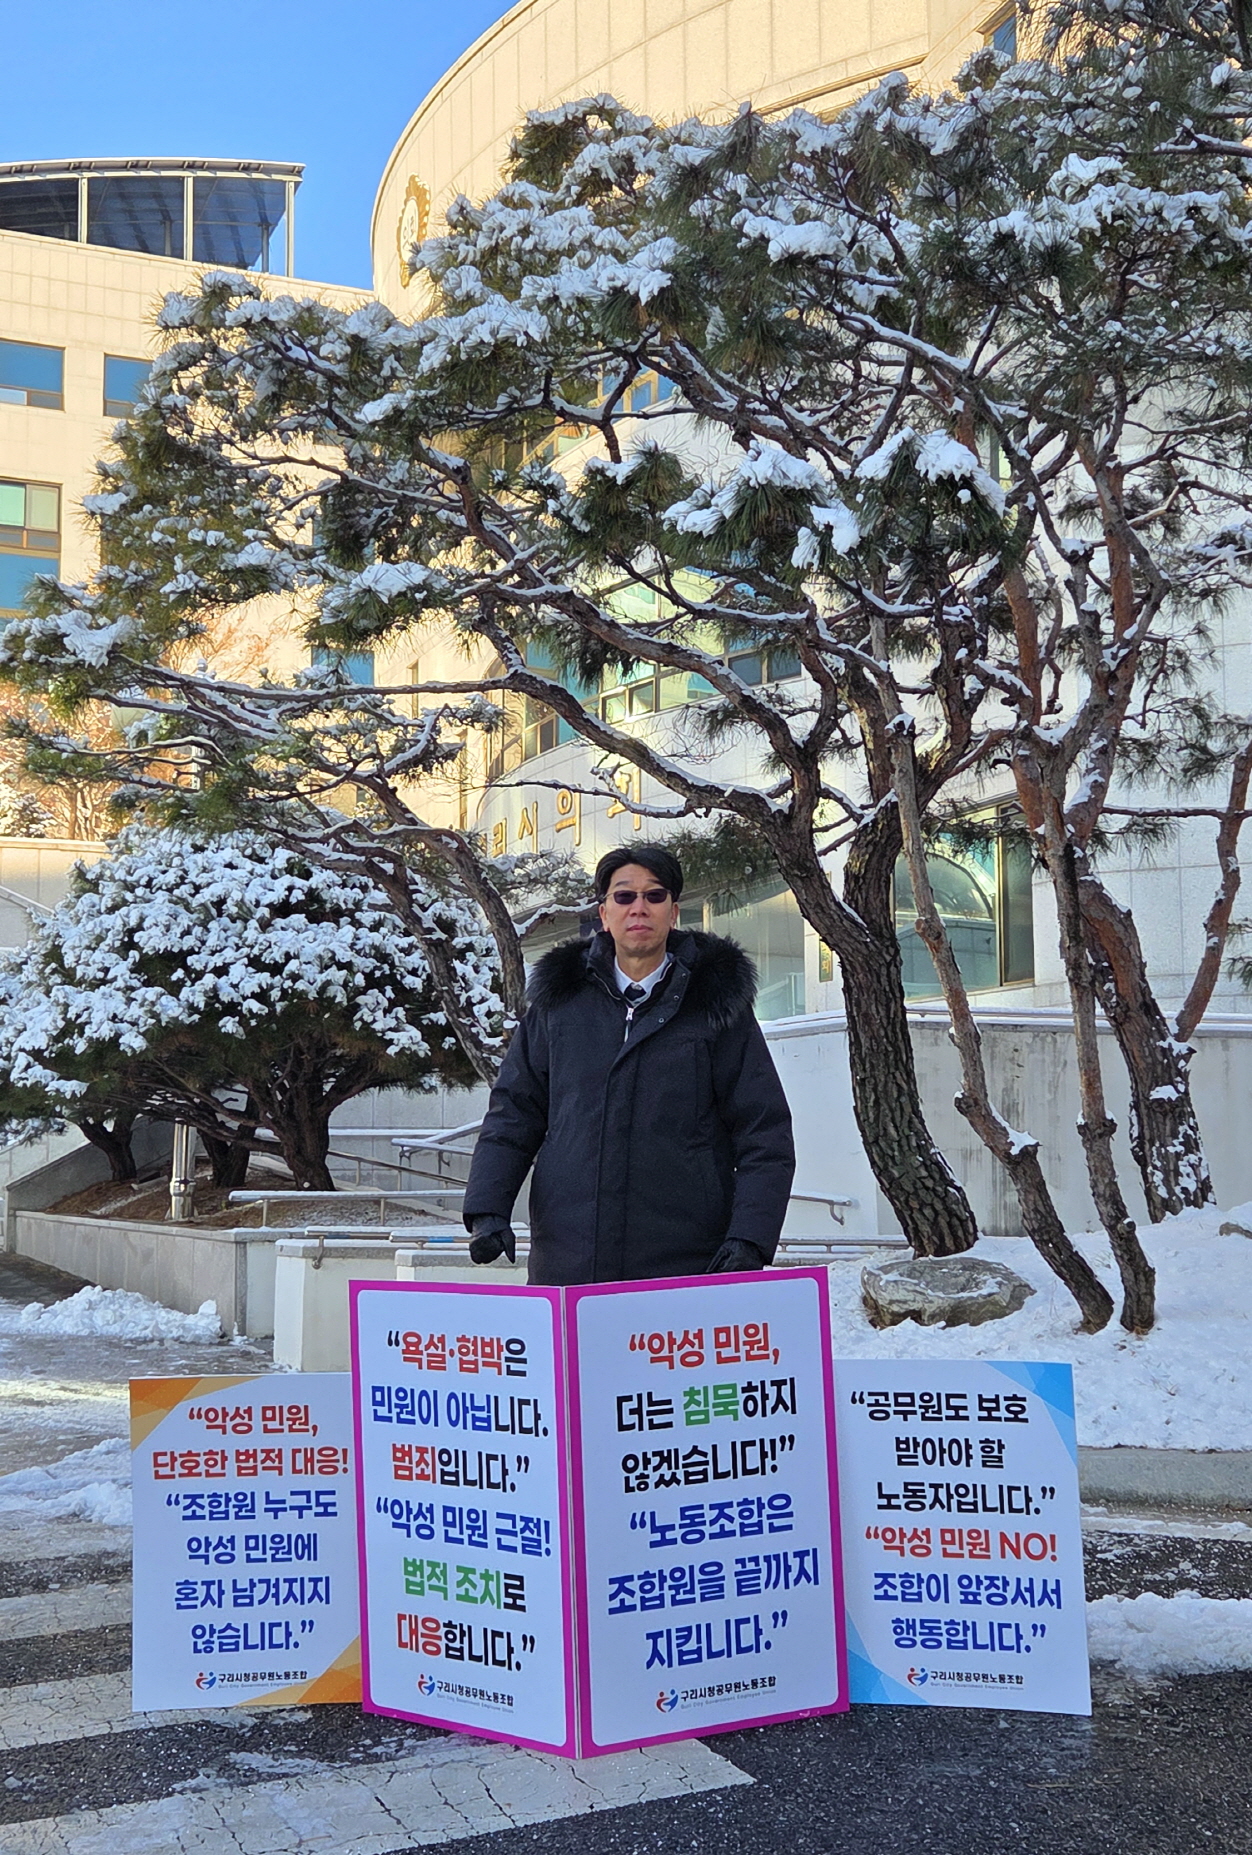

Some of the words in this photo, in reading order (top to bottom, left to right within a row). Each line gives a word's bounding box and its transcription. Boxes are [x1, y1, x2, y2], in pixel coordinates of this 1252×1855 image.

[481, 767, 642, 858] 리시의회
[371, 1385, 439, 1428] 민원이
[446, 1391, 549, 1438] 아닙니다.
[616, 1391, 675, 1433] 더는
[682, 1376, 797, 1425] 침묵하지
[977, 1393, 1030, 1424] 보호
[152, 1449, 229, 1480] 단호한
[235, 1447, 283, 1477] 법적
[291, 1446, 349, 1476] 대응!
[894, 1436, 974, 1468] 받아야
[978, 1437, 1006, 1469] 할
[263, 1489, 338, 1520] 누구도
[186, 1534, 236, 1566] 악성
[244, 1532, 318, 1564] 민원에
[441, 1504, 489, 1549] 민원
[494, 1511, 552, 1558] 근절!
[939, 1528, 991, 1560] 민원
[999, 1531, 1058, 1562] NO!
[174, 1578, 226, 1611] 혼자
[231, 1575, 331, 1608] 남겨지지
[403, 1556, 449, 1601] 법적
[455, 1564, 527, 1613] 조치로
[607, 1560, 726, 1616] 조합원을
[733, 1547, 820, 1596] 끝까지
[873, 1571, 950, 1604] 조합이
[957, 1573, 1062, 1610] 앞장서서
[681, 1676, 777, 1702] 구리시청공무원노동조합
